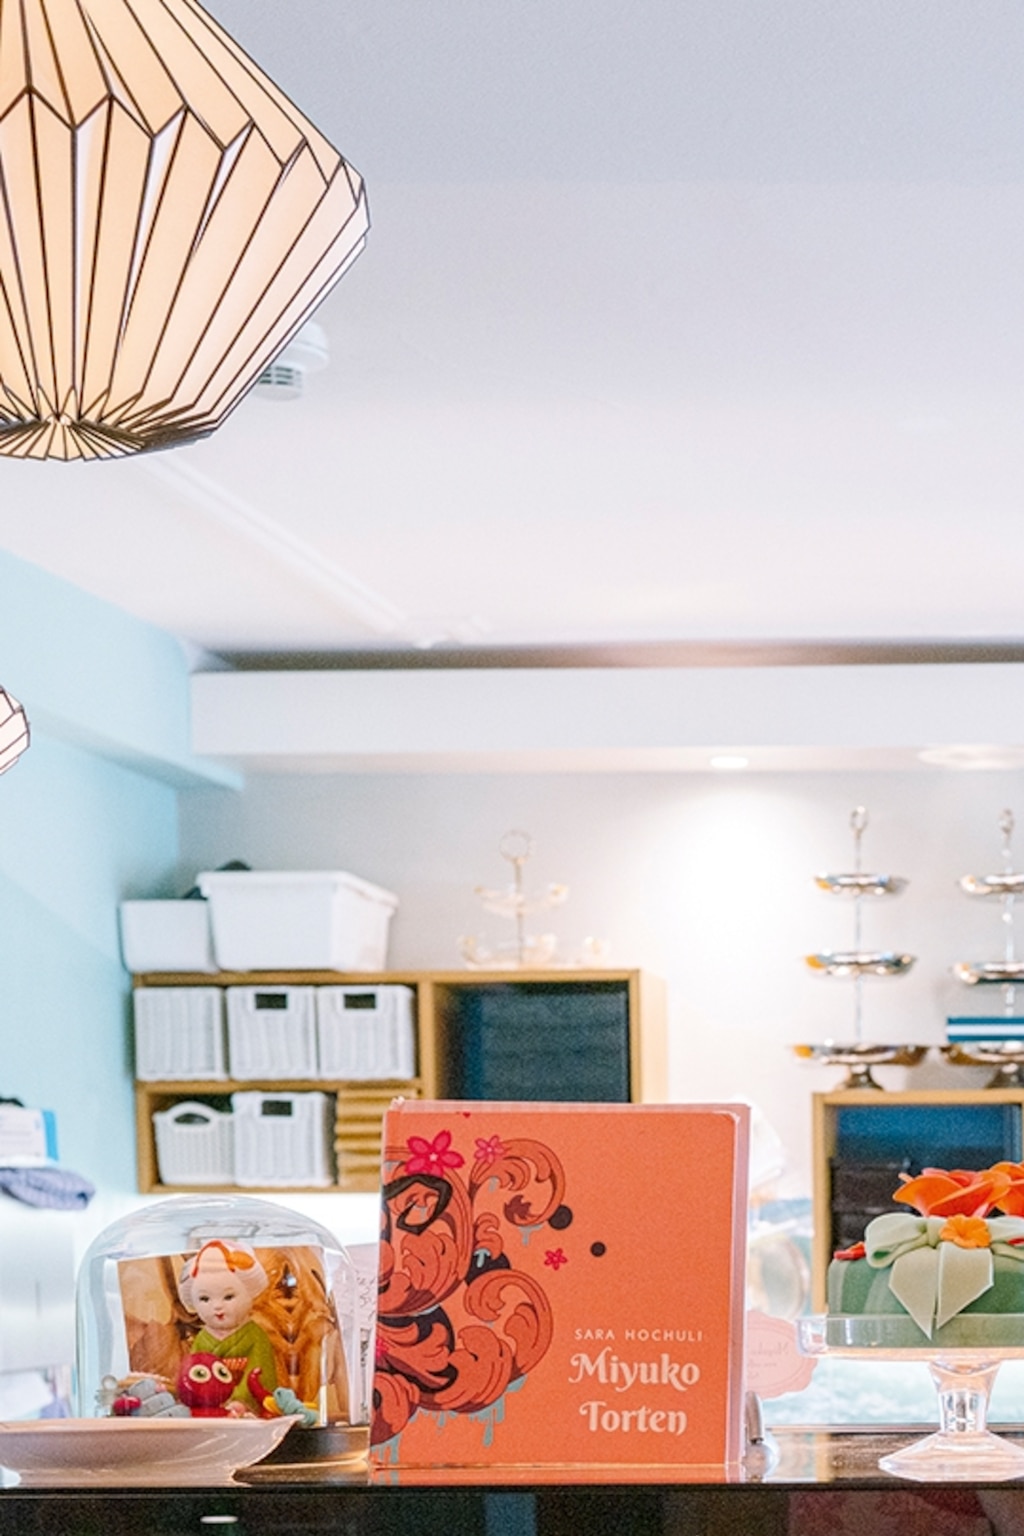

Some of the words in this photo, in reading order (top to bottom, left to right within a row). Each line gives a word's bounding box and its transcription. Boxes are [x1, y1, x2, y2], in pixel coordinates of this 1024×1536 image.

[574, 1328, 615, 1340] SARA
[624, 1328, 703, 1342] HOCHULI
[568, 1346, 701, 1392] Miyuko
[578, 1400, 688, 1436] Torten
